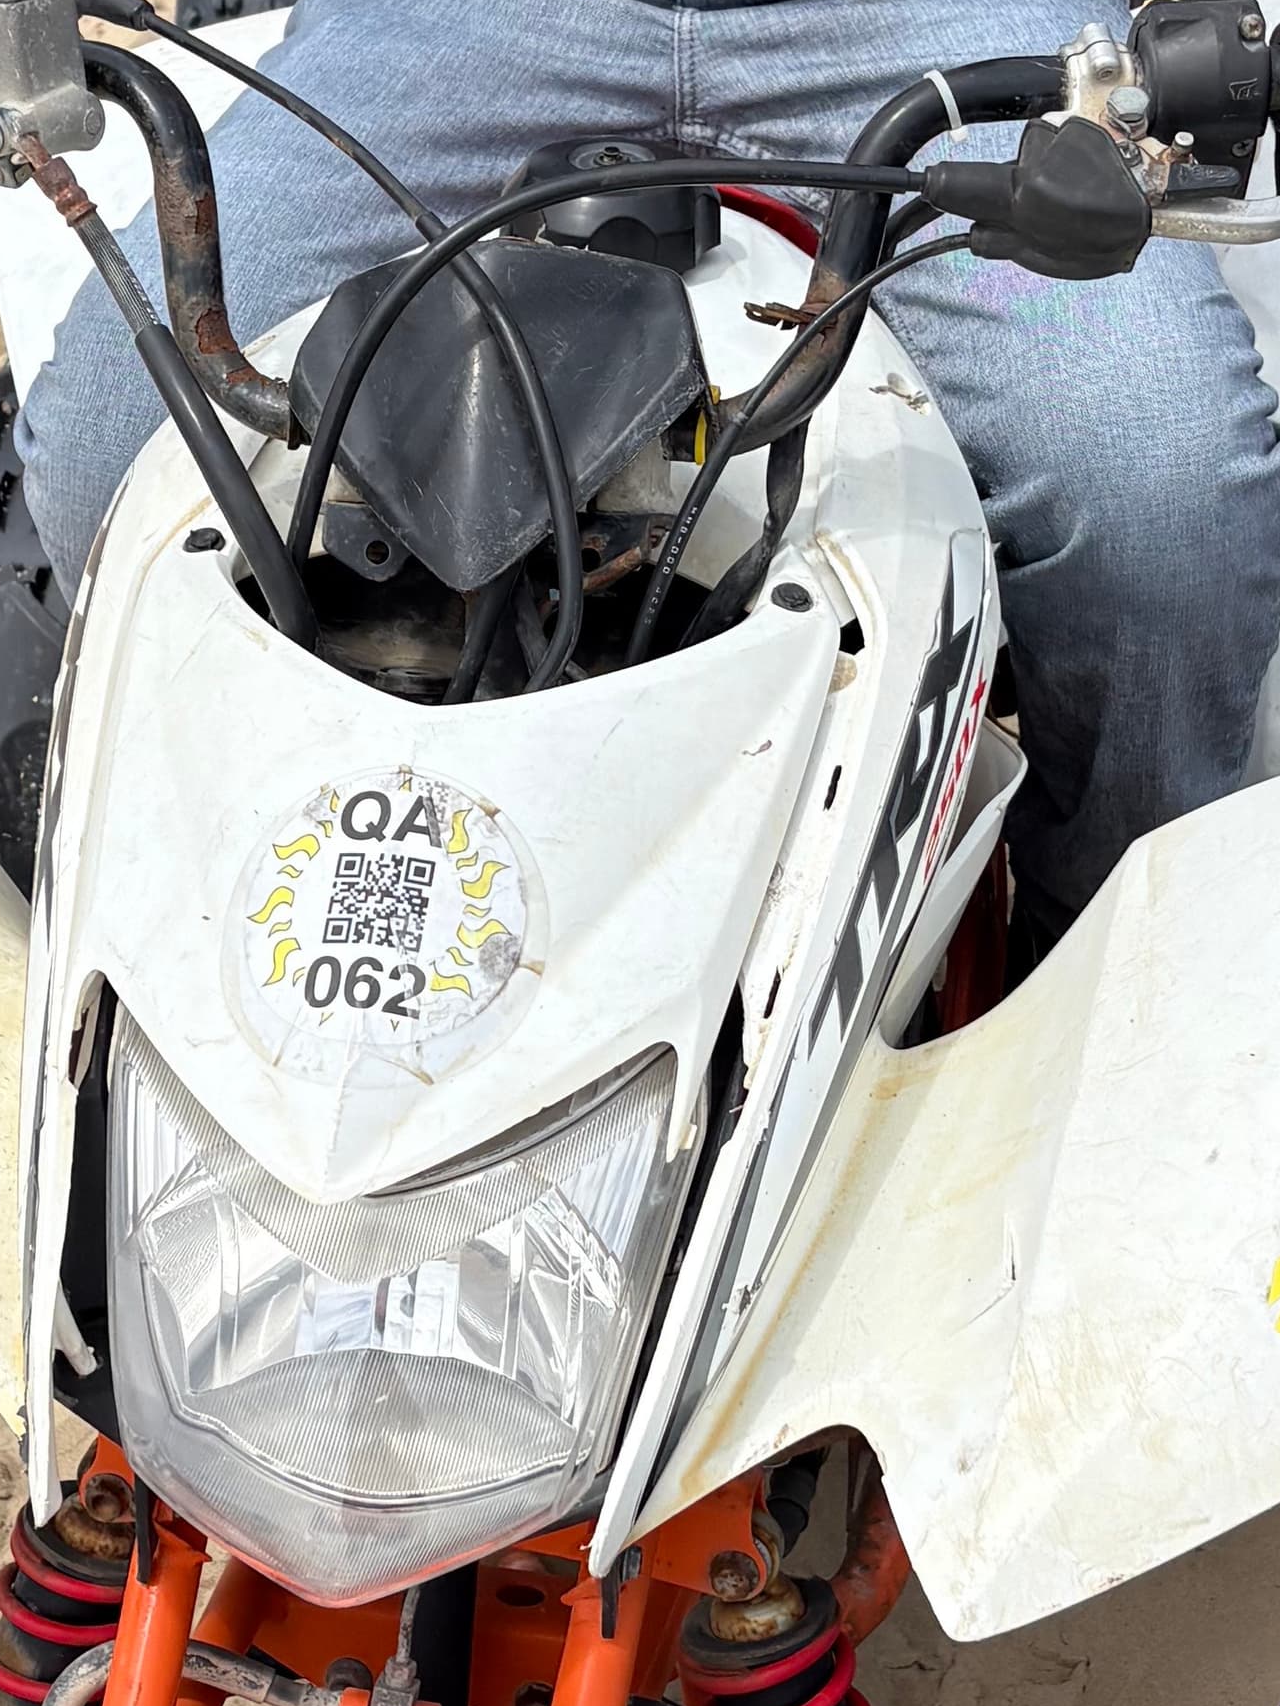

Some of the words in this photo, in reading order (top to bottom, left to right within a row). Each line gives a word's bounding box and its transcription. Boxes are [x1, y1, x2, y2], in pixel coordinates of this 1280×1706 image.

[340, 790, 443, 848] QA
[806, 558, 975, 1062] TRX
[923, 659, 987, 886] 250X
[303, 955, 427, 1020] 062
